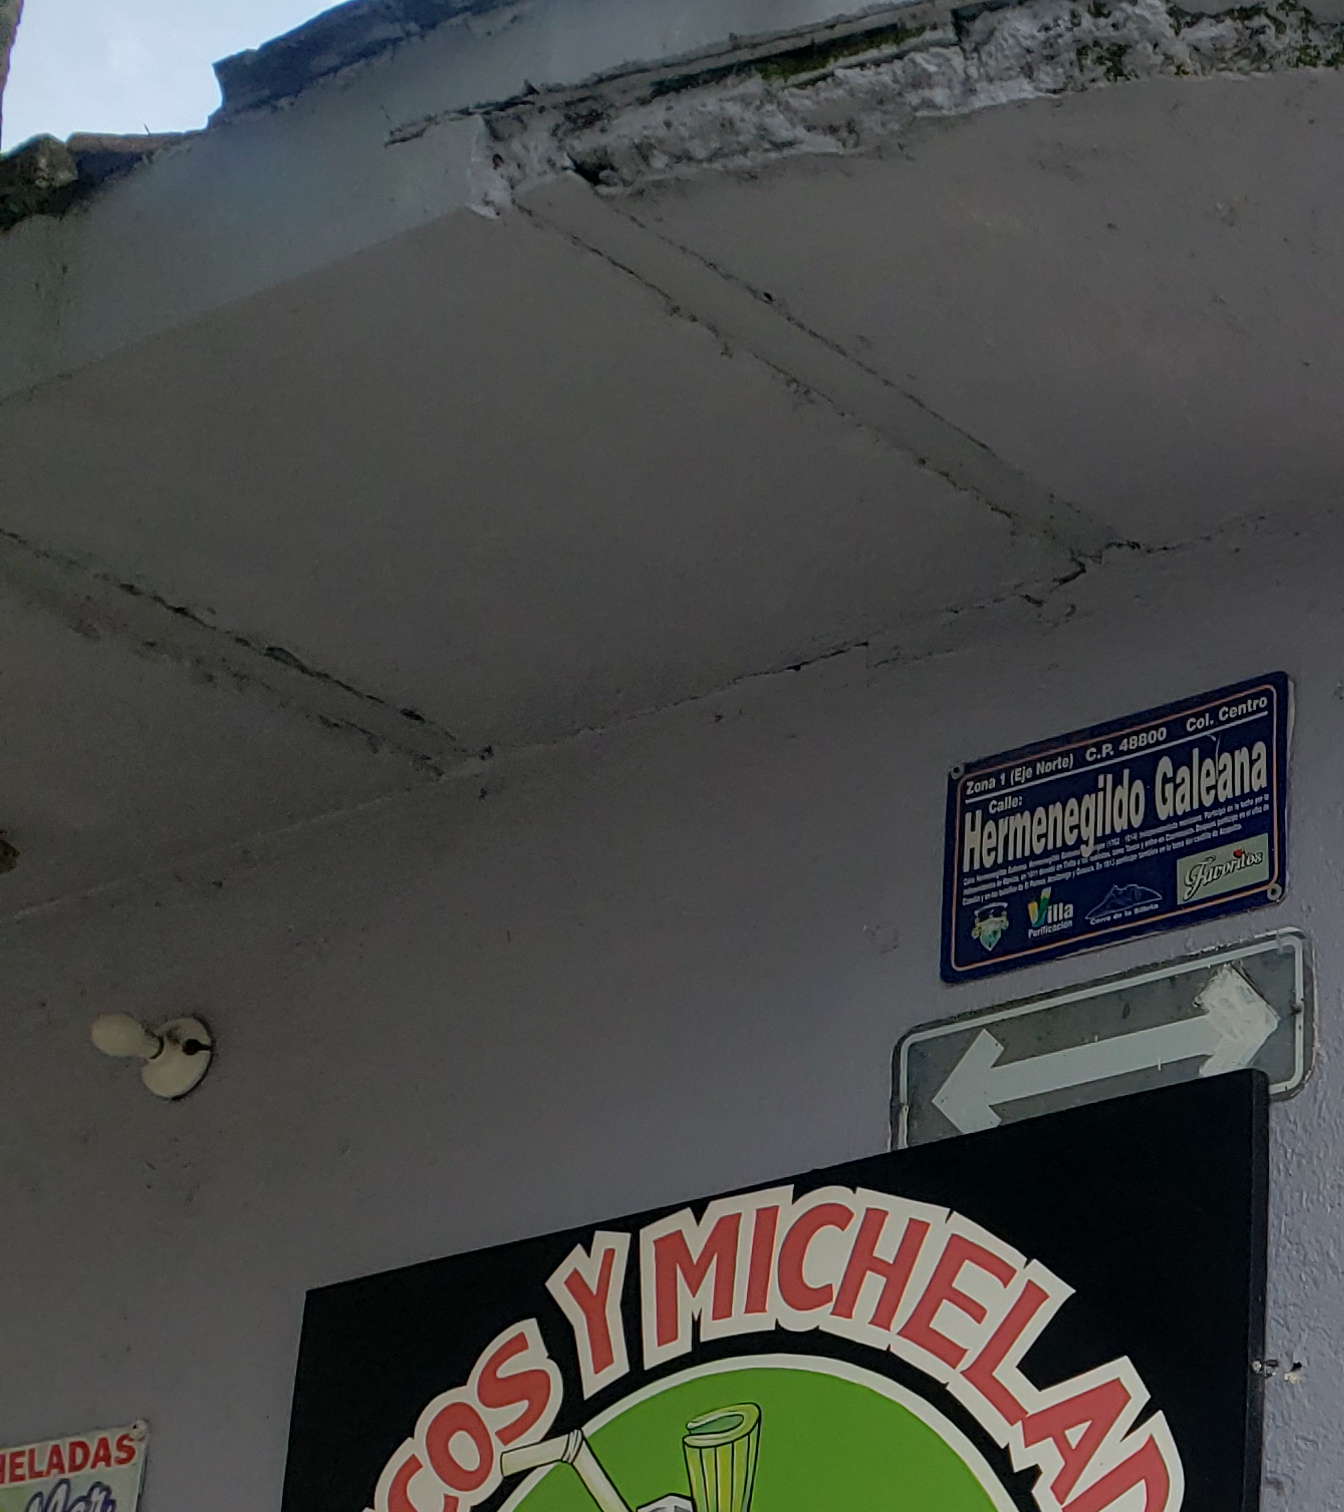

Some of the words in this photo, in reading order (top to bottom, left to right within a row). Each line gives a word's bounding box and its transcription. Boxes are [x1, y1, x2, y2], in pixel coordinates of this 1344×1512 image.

[966, 778, 996, 795] Zona
[1000, 772, 1006, 786] 1
[1036, 753, 1074, 775] Norte)
[1085, 743, 1114, 762] C.P.
[1118, 727, 1167, 751] 48800
[1186, 713, 1214, 732] Col.
[1218, 696, 1268, 721] Centro
[963, 768, 1146, 873] Hermenegildo
[1154, 741, 1268, 820] Galeana
[988, 795, 1023, 814] Calle:
[1028, 886, 1074, 927] Villa
[1183, 849, 1263, 902] Favoritos
[554, 1239, 624, 1388] Y
